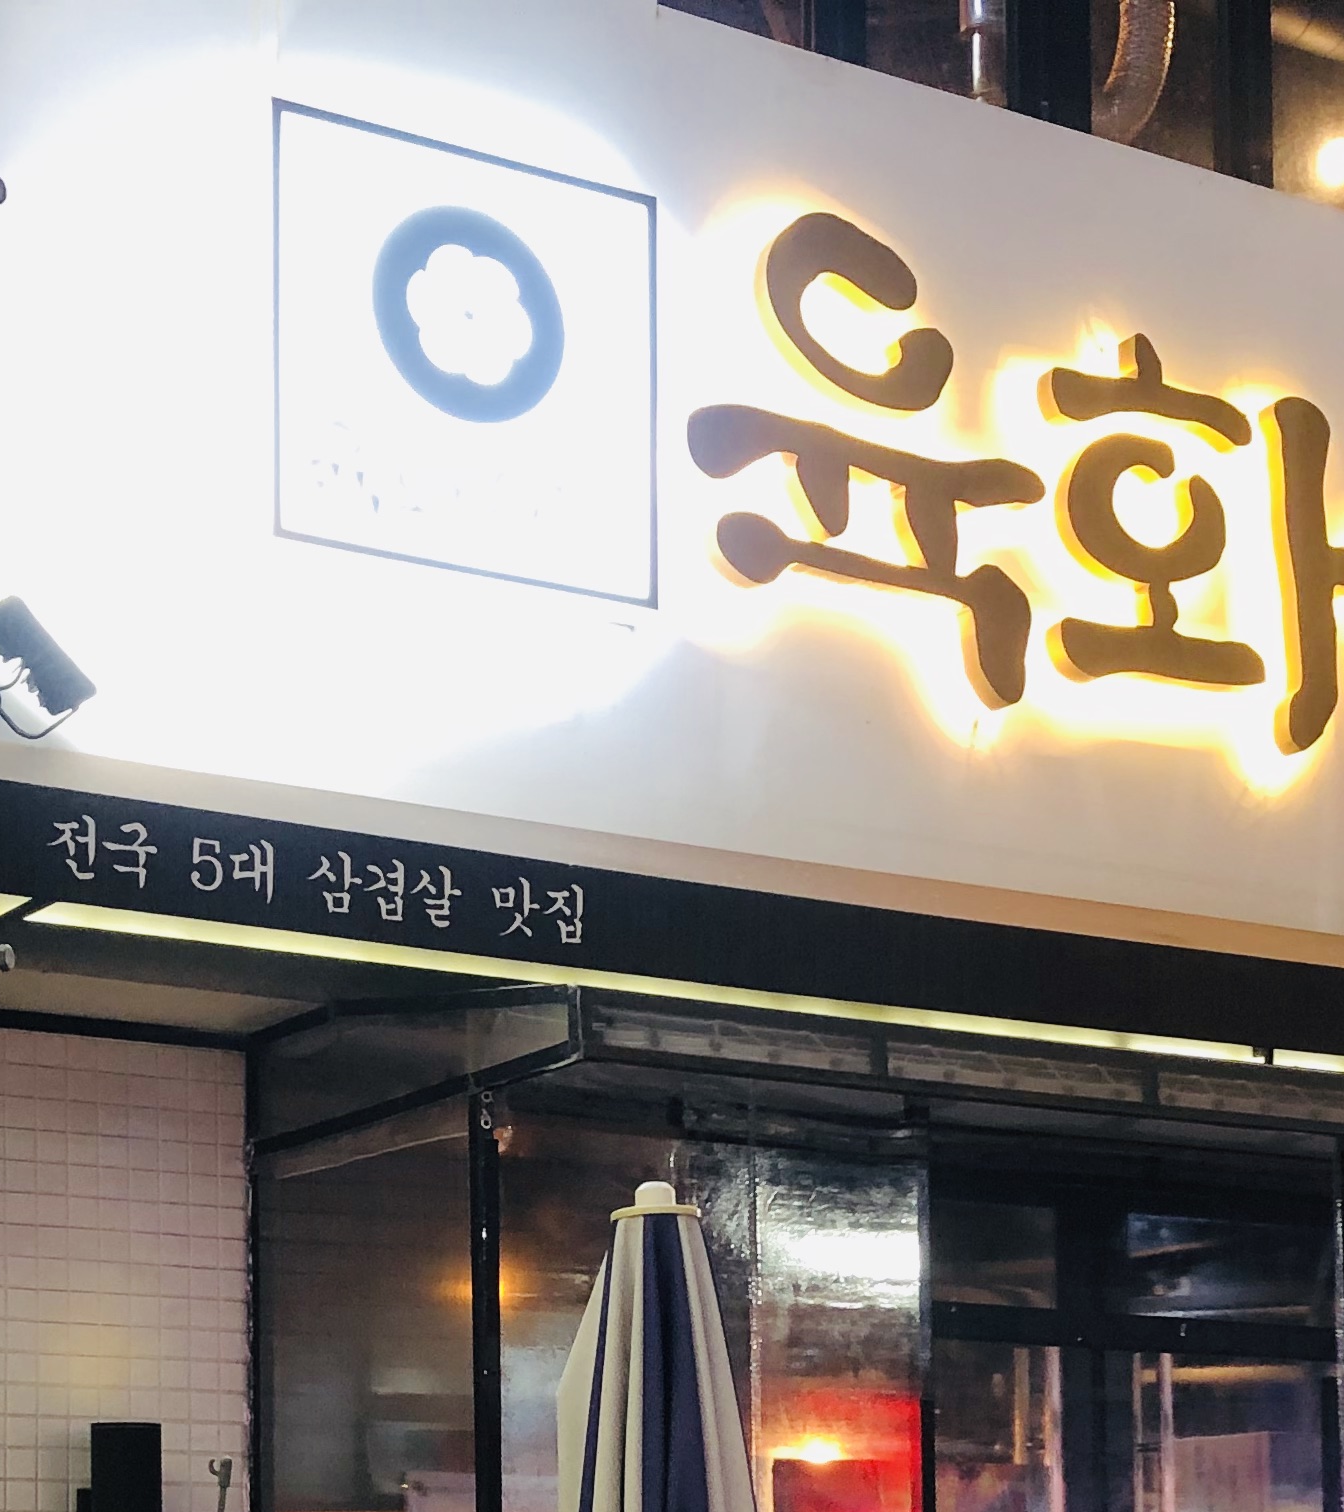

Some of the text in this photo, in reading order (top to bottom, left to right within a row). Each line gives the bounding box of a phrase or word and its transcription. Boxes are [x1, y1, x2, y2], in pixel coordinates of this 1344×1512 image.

[47, 815, 586, 944] 전국 5대 삼겹살 맛집
